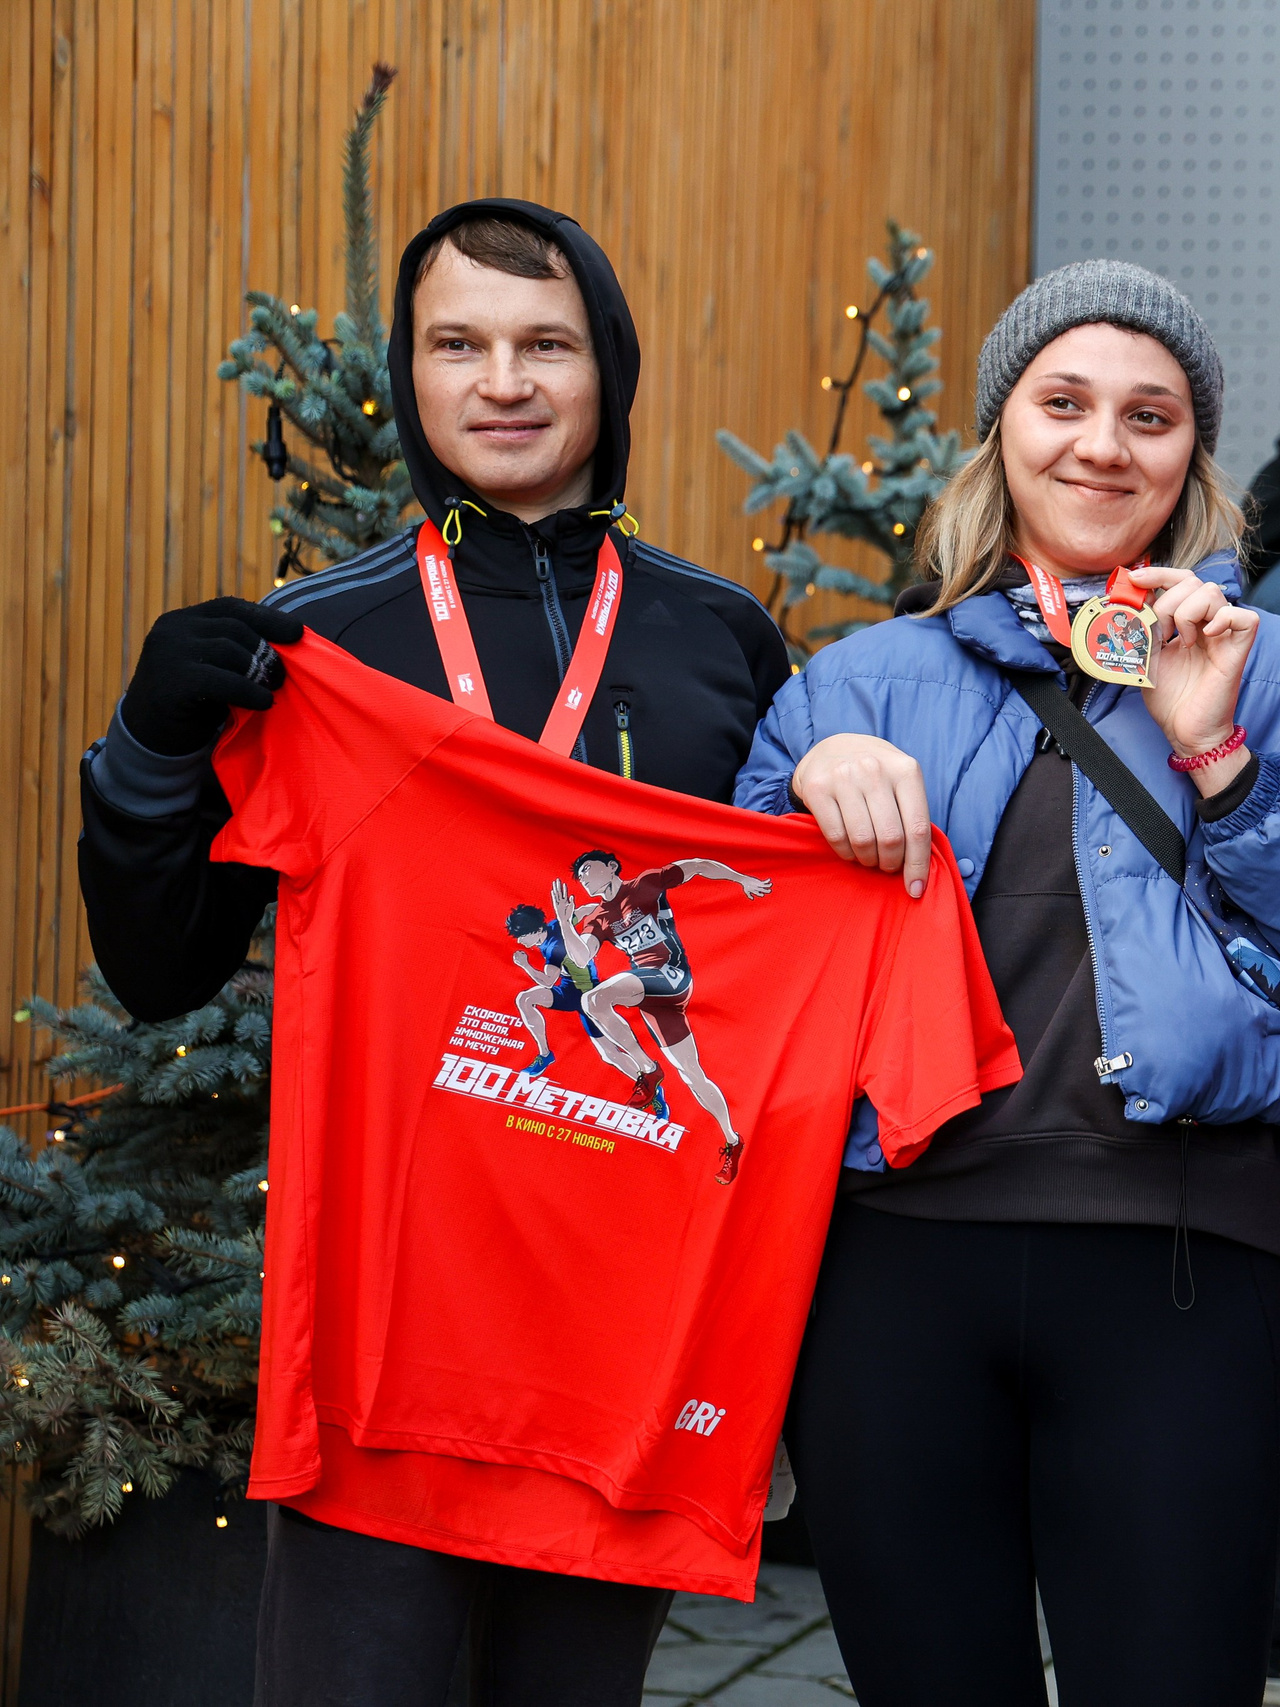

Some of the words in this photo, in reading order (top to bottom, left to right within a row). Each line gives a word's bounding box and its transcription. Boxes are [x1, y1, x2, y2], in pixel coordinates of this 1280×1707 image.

[621, 924, 656, 949] 273
[459, 1016, 480, 1028] ЭТО
[481, 1021, 509, 1037] ВОЛЯ,
[464, 1005, 524, 1027] СКОРОСТЬ
[449, 1036, 464, 1046] НА
[465, 1040, 500, 1055] МЕЧТУ
[454, 1026, 525, 1050] УМНОЖЕННАЯ
[434, 1053, 512, 1100] 100
[506, 1114, 514, 1129] В
[516, 1117, 546, 1137] КИНО
[546, 1124, 554, 1139] С
[556, 1127, 572, 1142] 27
[572, 1132, 615, 1154] НОЯБРЯ
[674, 1399, 726, 1437] GRi
